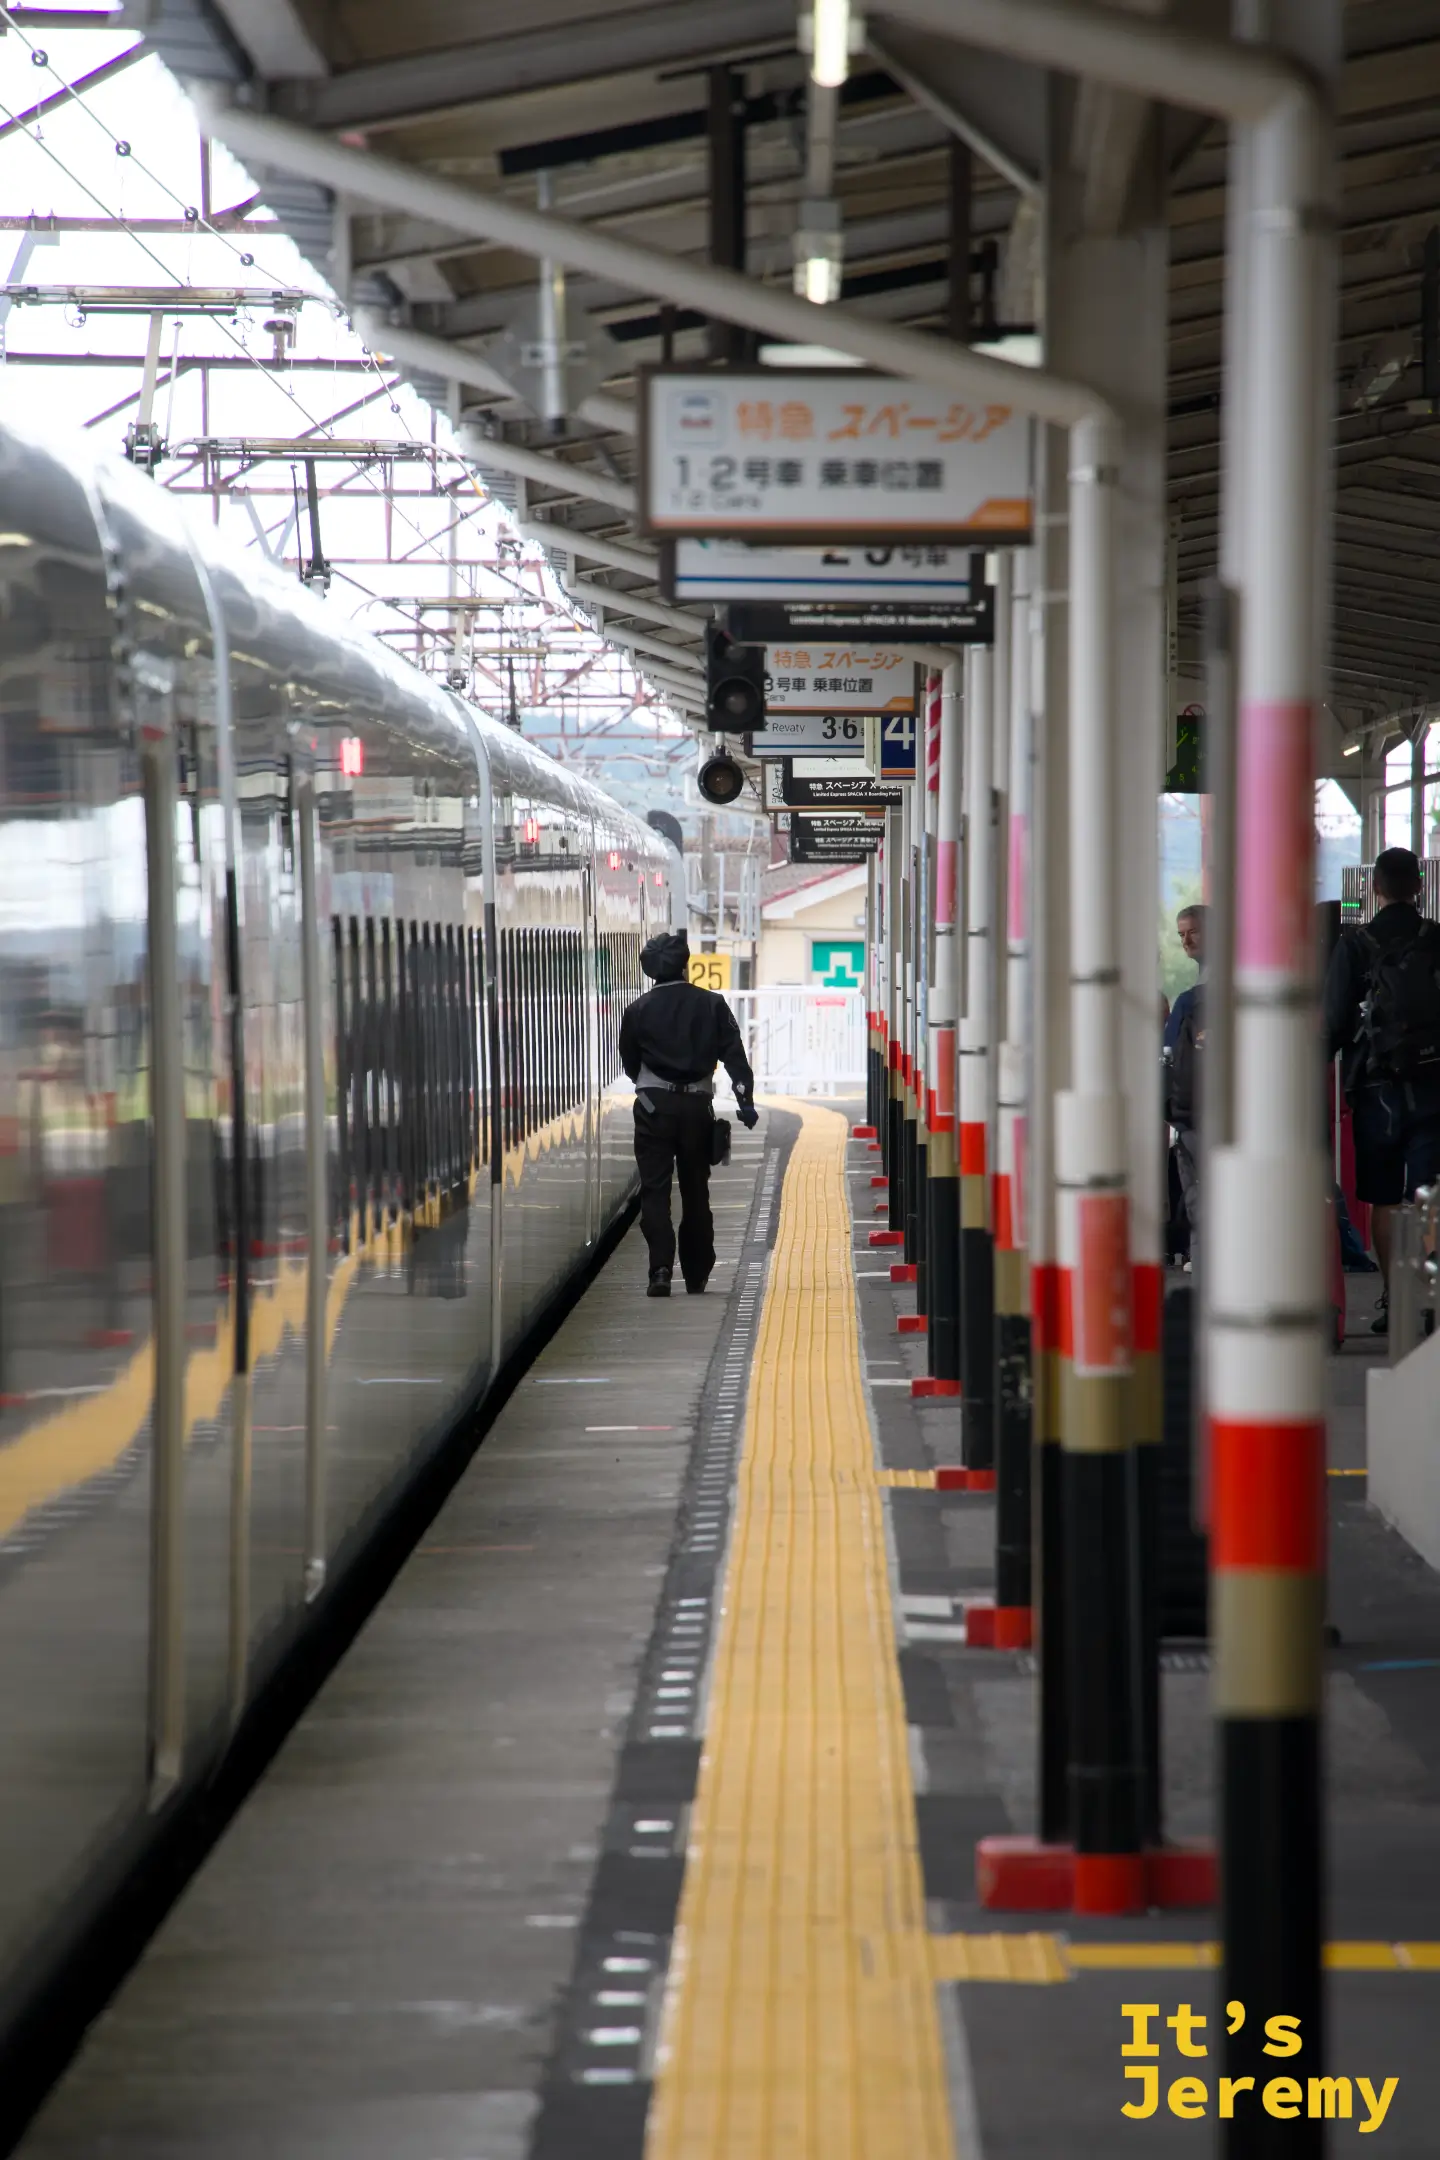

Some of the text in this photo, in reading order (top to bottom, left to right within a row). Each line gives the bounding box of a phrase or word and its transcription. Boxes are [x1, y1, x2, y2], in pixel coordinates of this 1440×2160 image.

[774, 650, 904, 670] 特急 スペーシア
[813, 678, 873, 693] 乗車位置
[772, 723, 805, 733] Revaty
[884, 717, 914, 750] 4
[825, 781, 868, 790] スペーシア
[691, 962, 722, 991] 25
